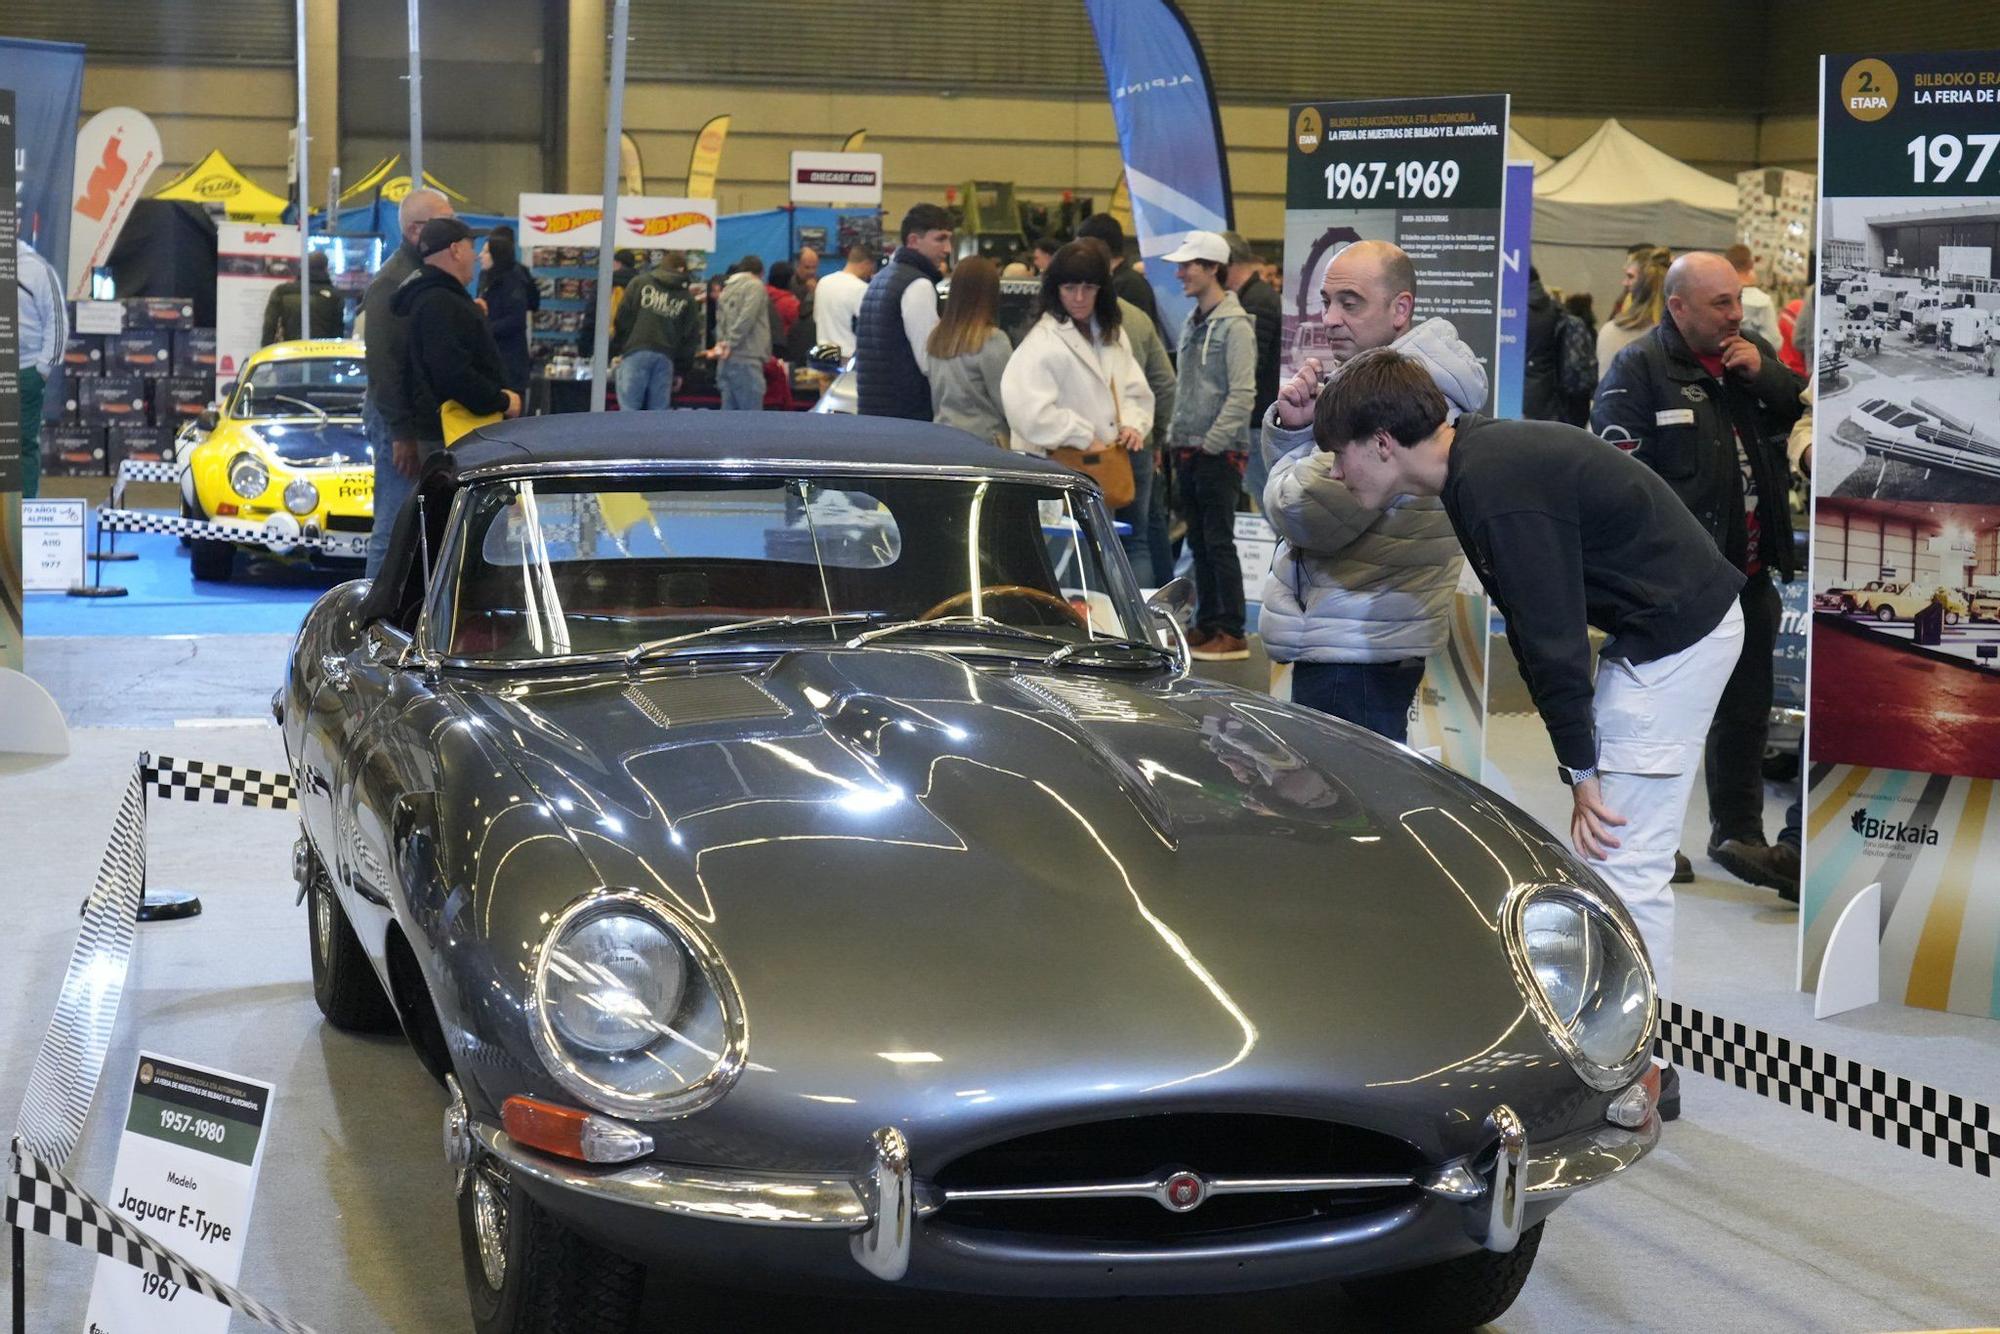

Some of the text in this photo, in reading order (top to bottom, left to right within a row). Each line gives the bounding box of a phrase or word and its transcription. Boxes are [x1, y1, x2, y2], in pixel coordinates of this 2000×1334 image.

[1858, 71, 1880, 93] 2.
[1915, 73, 1976, 87] BILBOKO
[1850, 97, 1888, 108] ETAPA
[1914, 90, 1994, 104] LA FERIA DE
[1299, 135, 1318, 145] ETAPA
[1329, 122, 1498, 141] LA FERIA DE MUESTRAS DE BILBAO Y EL AUTOMÓVIL
[1907, 133, 2000, 184] 197
[1324, 159, 1461, 200] 1967-1969
[339, 486, 375, 498] Ren
[1864, 818, 1939, 846] Bizkaia
[161, 1109, 225, 1143] 1957-1980
[167, 1171, 197, 1190] Modelo
[118, 1187, 232, 1243] Jaguar E-Type
[142, 1271, 181, 1302] 1967
